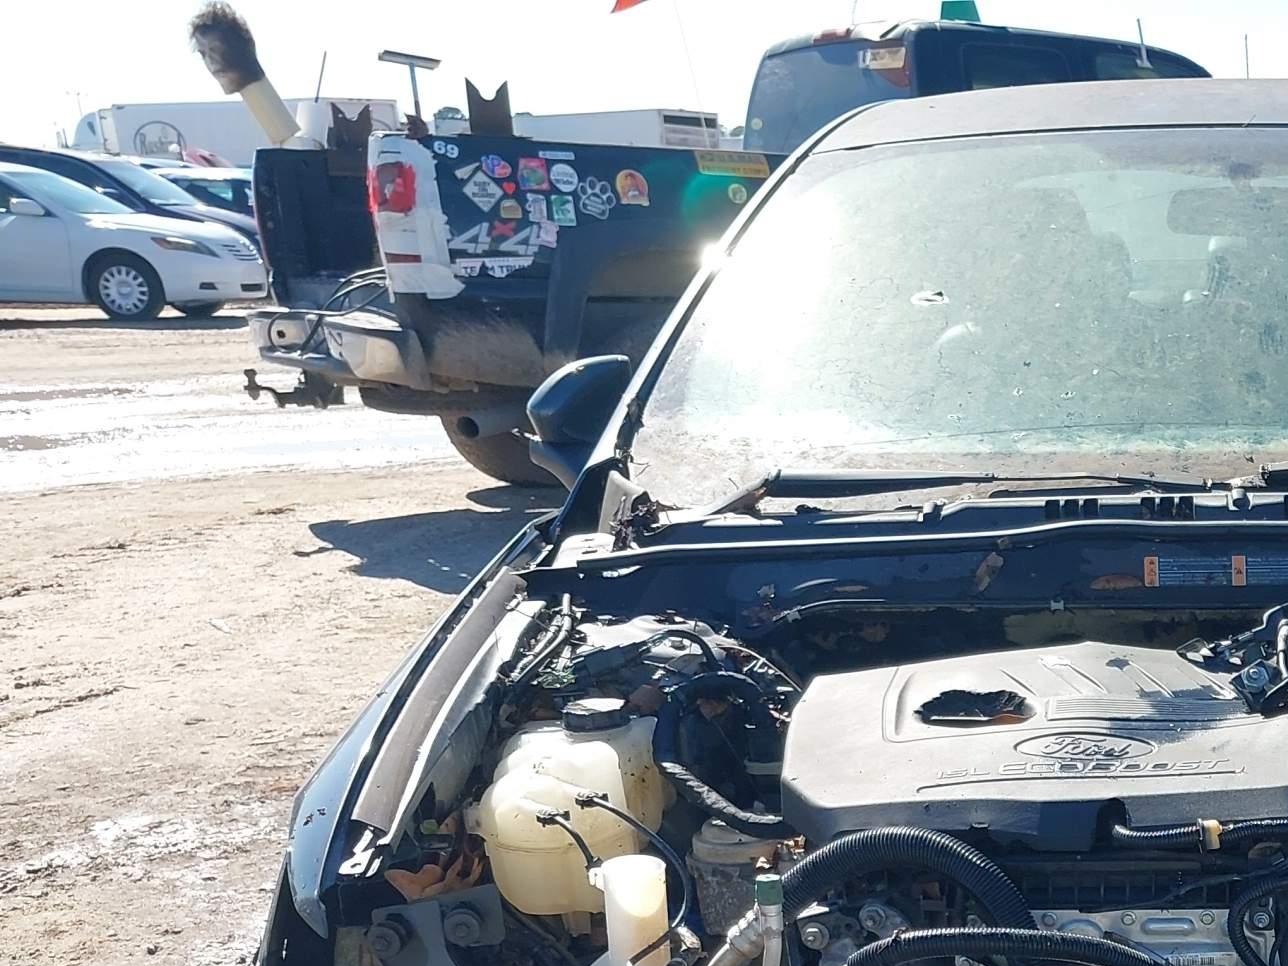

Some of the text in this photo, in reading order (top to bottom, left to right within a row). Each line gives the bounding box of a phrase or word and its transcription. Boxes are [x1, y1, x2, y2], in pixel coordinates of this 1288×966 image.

[433, 140, 460, 159] 69
[462, 265, 496, 275] TEM
[1042, 736, 1131, 757] Ford
